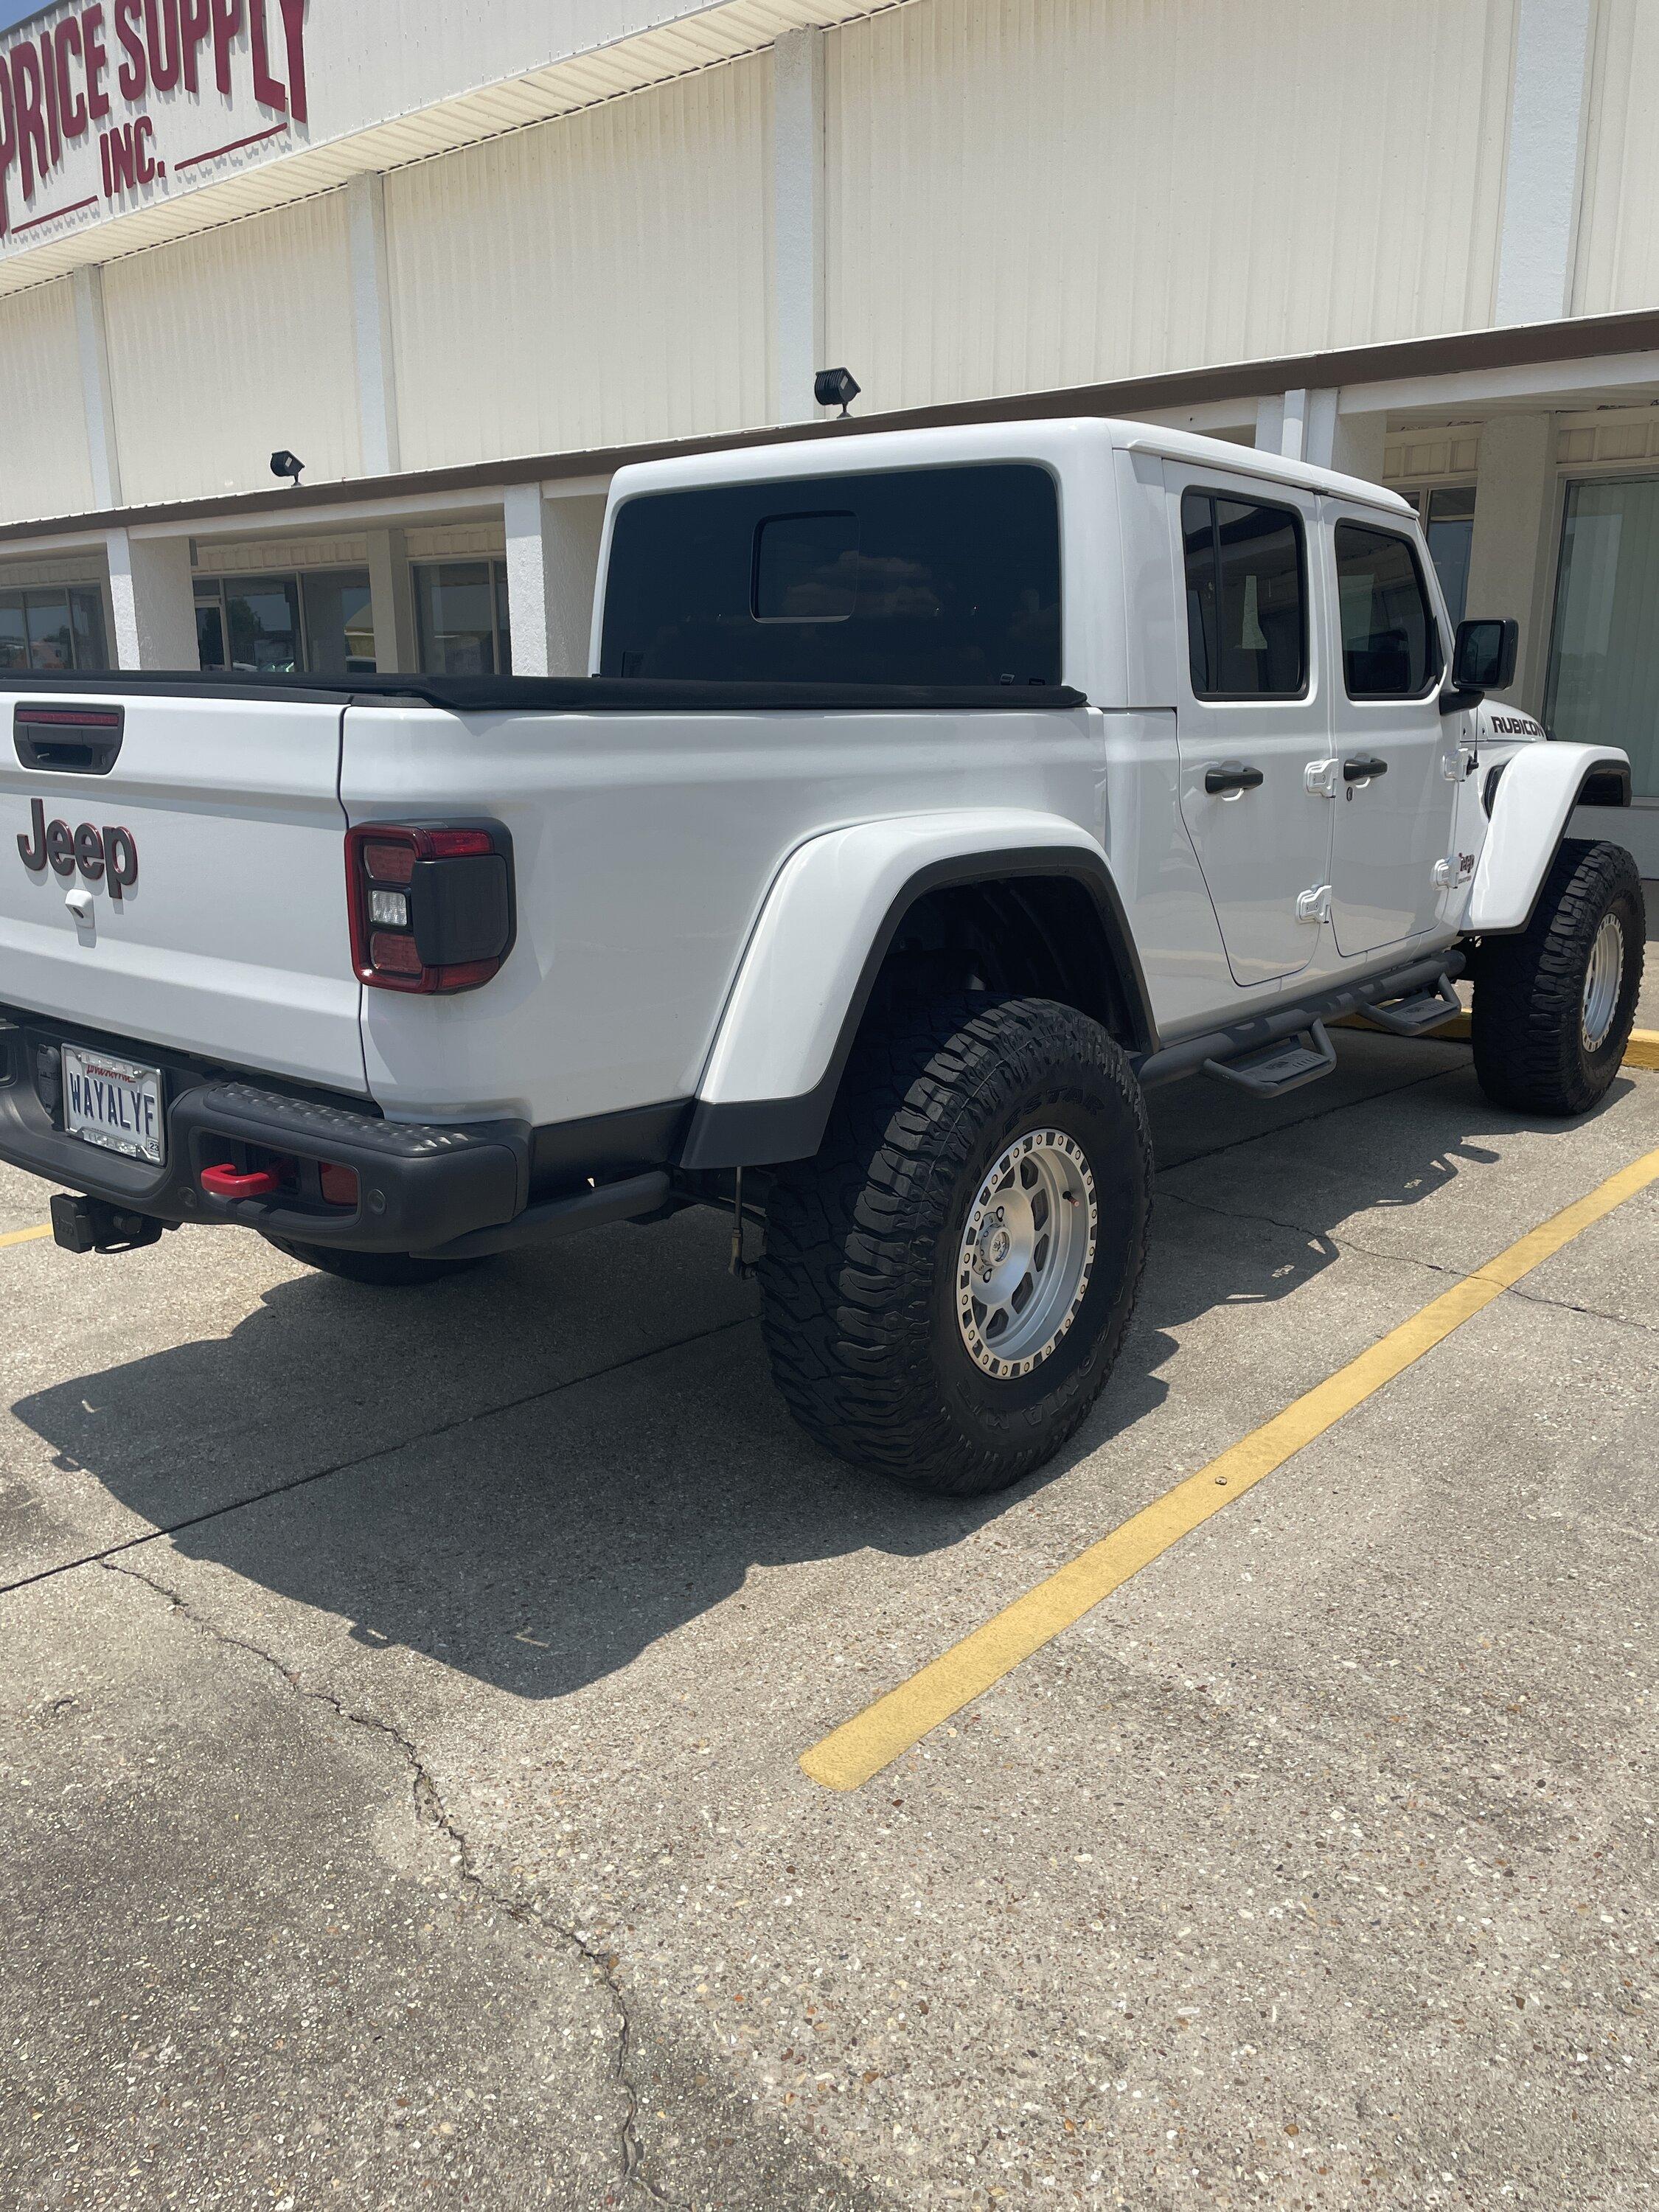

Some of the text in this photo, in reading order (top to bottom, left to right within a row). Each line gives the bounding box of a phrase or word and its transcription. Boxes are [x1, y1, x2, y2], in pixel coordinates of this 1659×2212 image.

[115, 0, 307, 124] SUPPLY
[100, 116, 165, 198] INC.
[1491, 716, 1544, 737] RUBICON
[17, 798, 138, 899] Jeep
[70, 1072, 155, 1135] WAYALYF
[150, 1142, 159, 1152] 23
